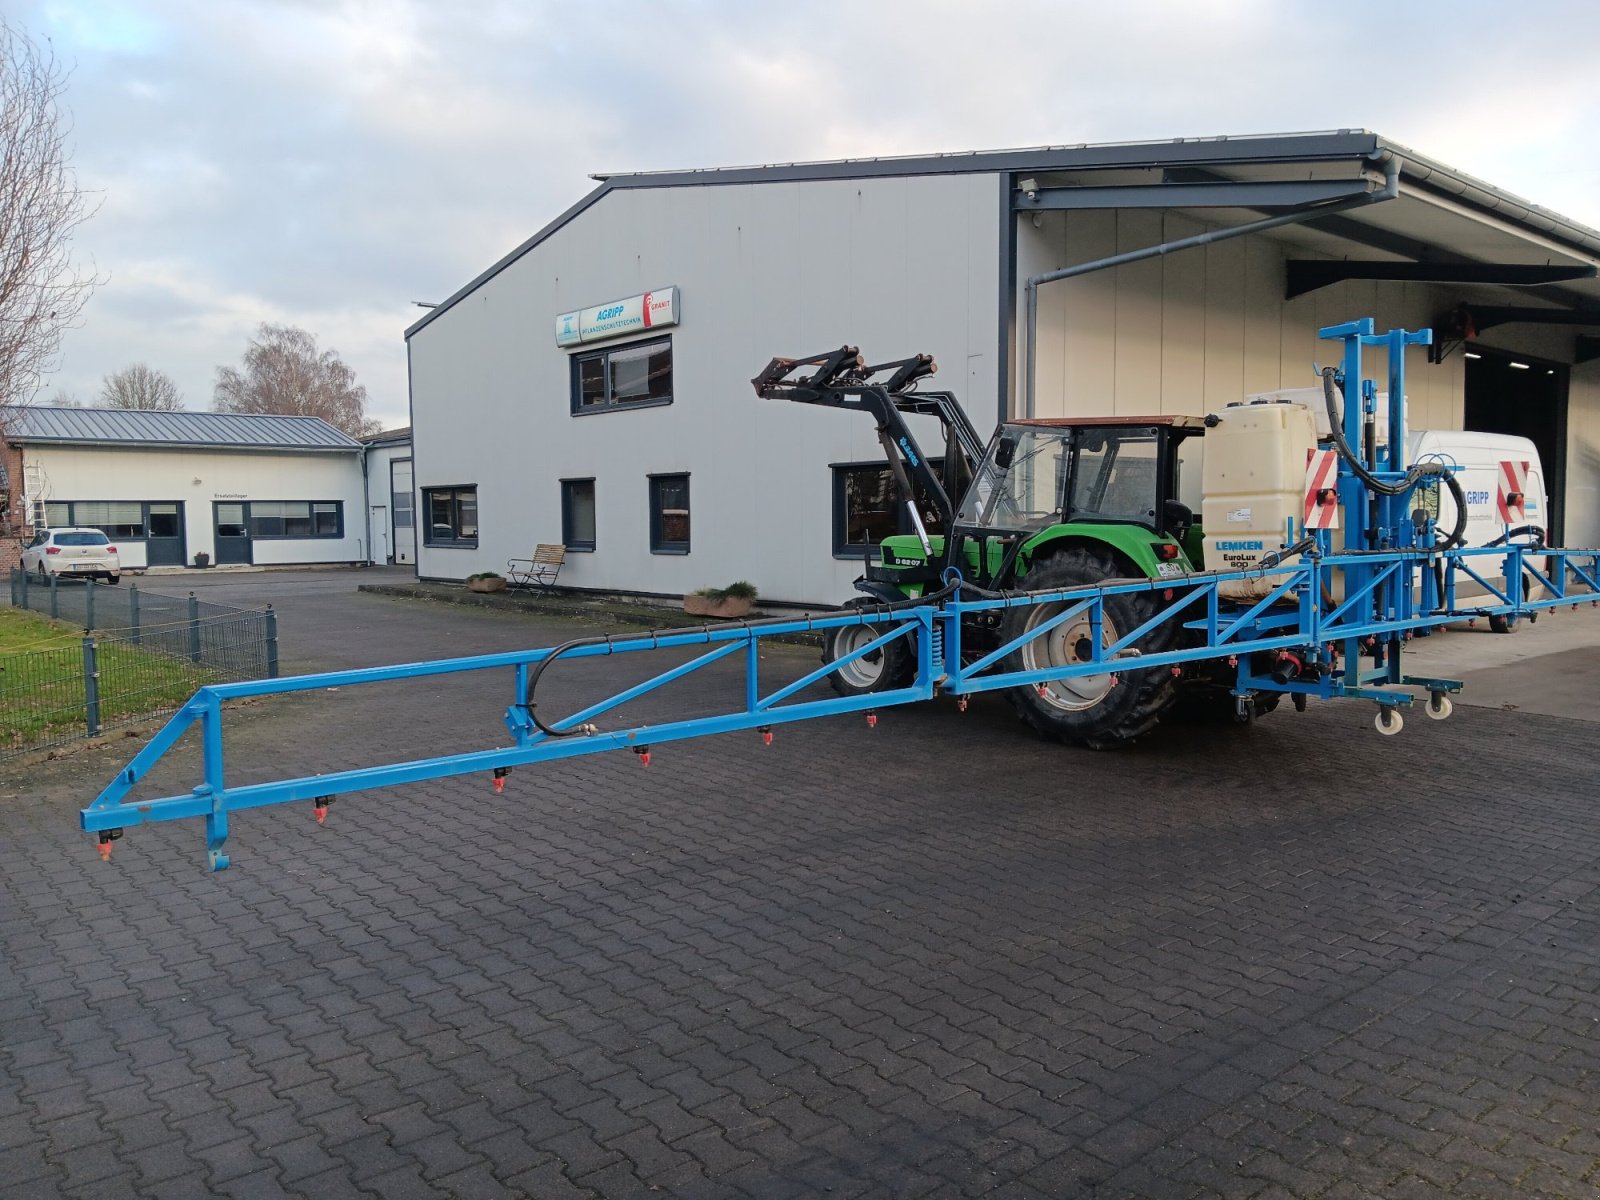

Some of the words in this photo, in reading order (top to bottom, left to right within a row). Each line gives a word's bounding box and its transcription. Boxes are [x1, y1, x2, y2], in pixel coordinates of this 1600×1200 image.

[597, 306, 624, 321] AGRIPP
[581, 316, 641, 335] PFLANZENSCHUTZTECHNIK
[1215, 541, 1264, 551] LEMKEN
[1223, 553, 1256, 561] EuroLux
